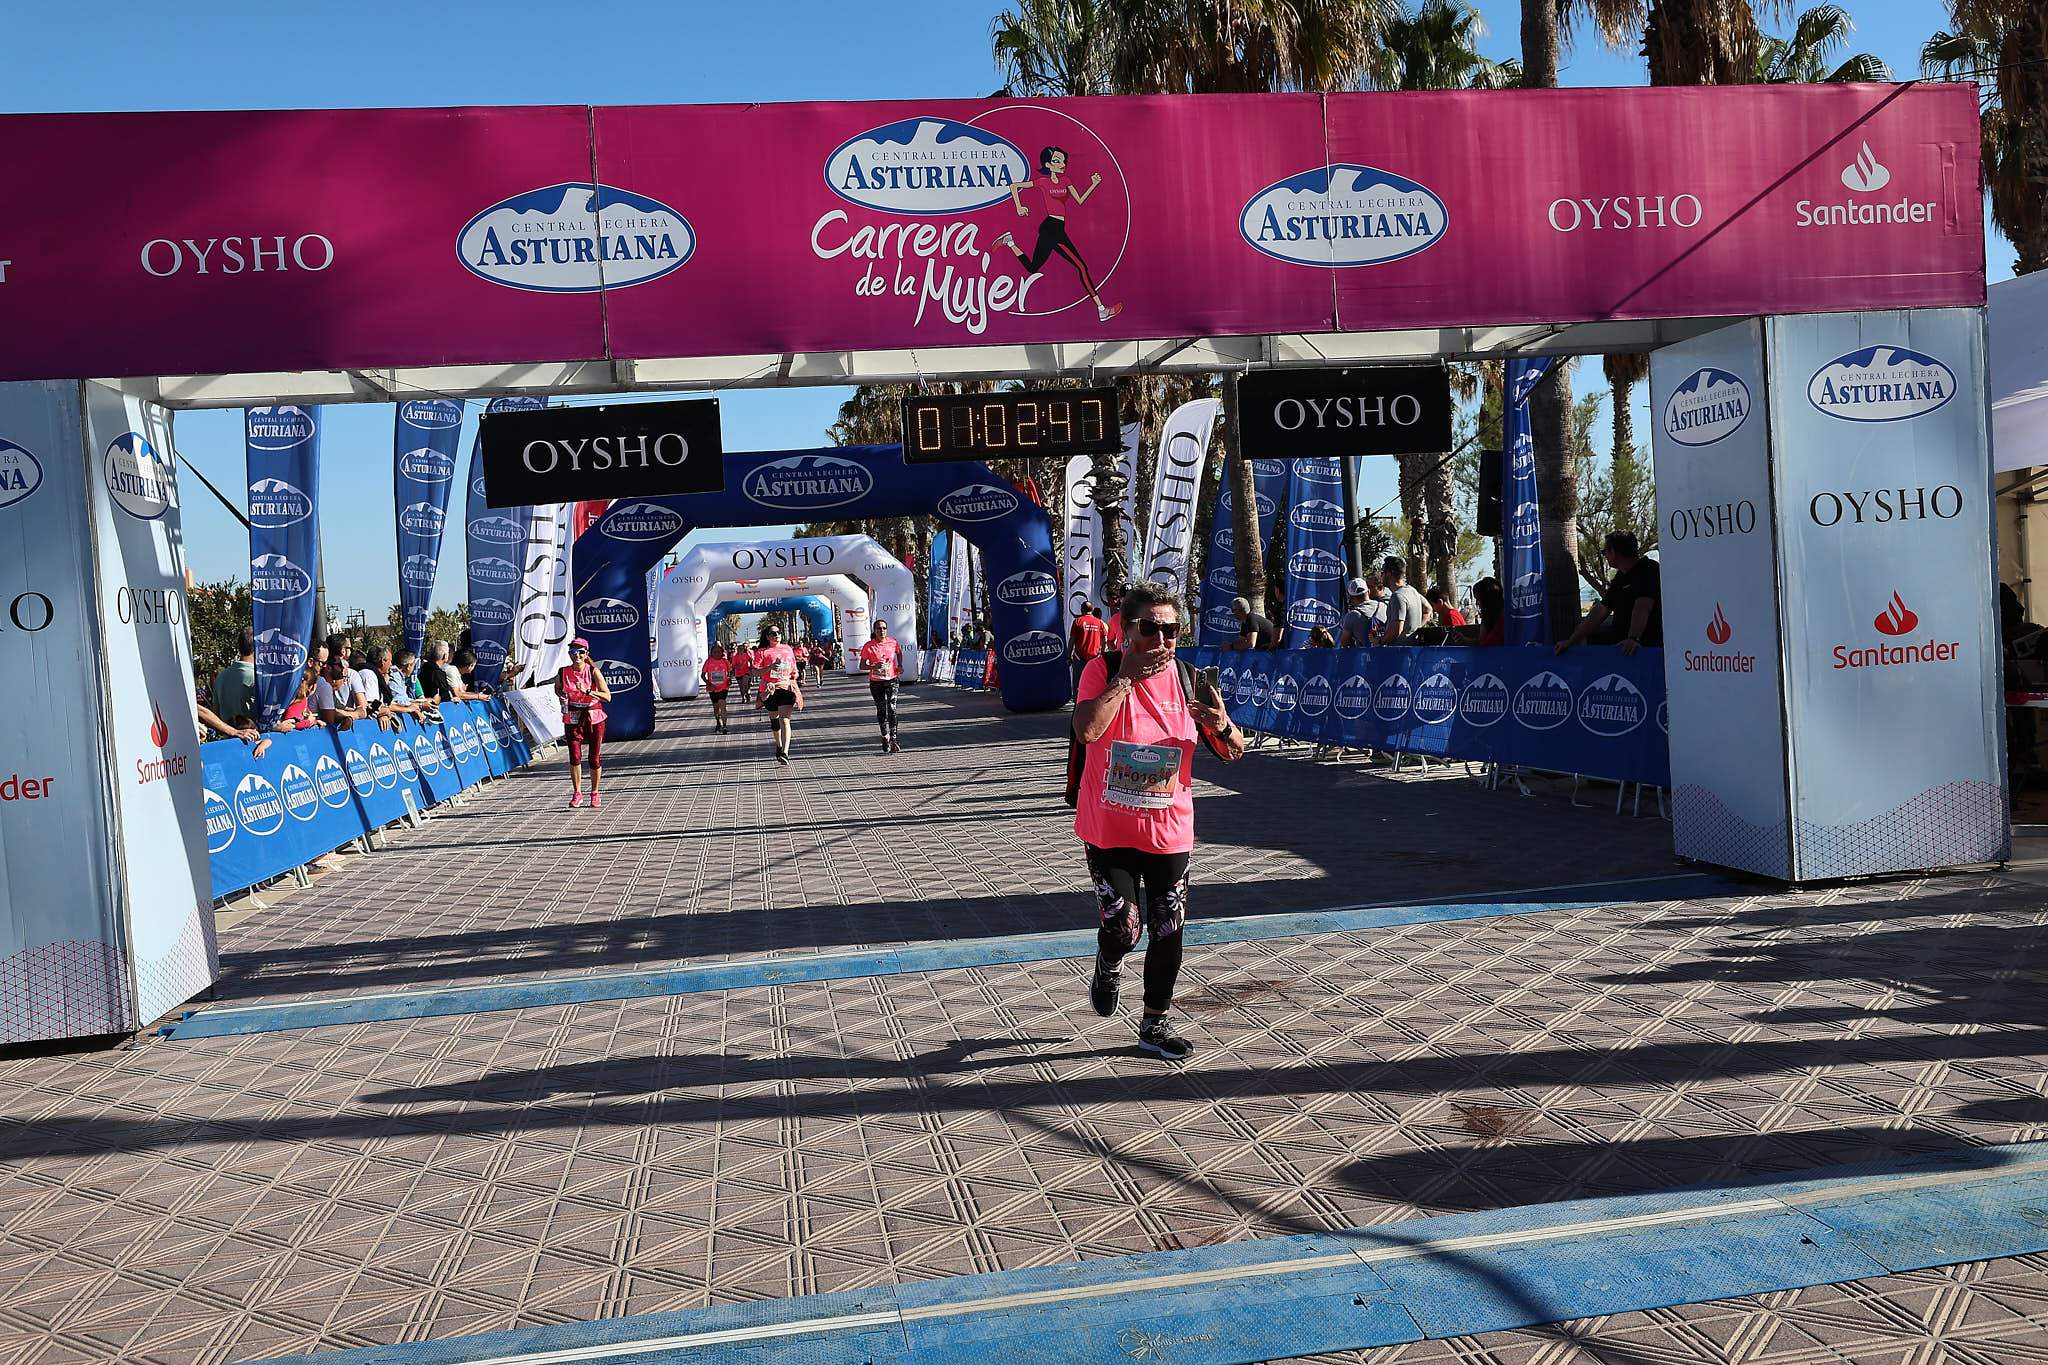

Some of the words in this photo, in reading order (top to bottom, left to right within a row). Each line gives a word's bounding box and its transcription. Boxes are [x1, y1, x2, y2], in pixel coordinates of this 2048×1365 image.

[871, 147, 936, 162] CENTRAL
[941, 146, 1008, 160] LECHERA
[841, 153, 1014, 191] ASTURIANA
[1287, 198, 1353, 211] CENTRAL
[1358, 196, 1426, 209] LECHERA
[1547, 193, 1703, 233] OYSHO
[1796, 197, 1937, 228] Santander
[511, 219, 587, 235] CENTRAL
[595, 216, 670, 231] ECHERA
[1257, 200, 1430, 243] ASTURIANA
[810, 208, 980, 261] Carrera
[140, 233, 335, 277] OYSHO
[477, 225, 679, 268] ASTURIANA
[855, 262, 887, 297] de
[893, 259, 916, 296] la
[911, 250, 1043, 334] Mujer
[1840, 372, 1888, 382] CENTRAL
[1891, 369, 1940, 380] LECHERA
[1680, 394, 1708, 408] CENTRAL
[1708, 386, 1740, 401] LECHERA
[1818, 376, 1947, 405] ASTURIANA
[406, 405, 457, 423] ASTURIANA
[1273, 394, 1422, 430] OYSHO
[1670, 396, 1745, 433] ASTURIANA
[917, 399, 1104, 451] 01:02:47
[522, 433, 690, 474] OYSHO
[110, 457, 169, 502] ASTURIANA
[771, 471, 814, 479] CENTRAL
[816, 468, 858, 477] LECHERA
[753, 474, 865, 497] ASTURIANA
[250, 503, 304, 516] STURIANA
[944, 499, 1014, 515] ASTURIANA
[1809, 485, 1964, 528] OYSHO
[471, 523, 523, 540] ASTURIANA
[605, 518, 677, 533] ASTURIANA
[1670, 500, 1756, 541] OYSHO
[732, 544, 835, 570] OYSHO
[864, 563, 895, 572] OYSHO
[671, 575, 704, 584] OYSHO
[1001, 584, 1055, 599] ASTURIANA
[117, 586, 181, 625] OYSHO
[882, 602, 911, 612] OYSHO
[579, 611, 635, 625] ASTURIANA
[660, 616, 690, 627] OYSHO
[662, 657, 692, 668] OYSHO
[1008, 644, 1062, 659] ASTURIANA
[1684, 649, 1756, 673] Santander
[1832, 638, 1960, 671] Santander
[1335, 691, 1368, 708] ASTURIANA
[1375, 691, 1408, 709] ASTURIANA
[1416, 691, 1453, 711] ASTURIANA
[1462, 691, 1504, 713] ASTURIANA
[1515, 692, 1568, 716] ASTURIANA
[1581, 695, 1638, 722] ASTURIANA
[137, 751, 188, 785] Santander
[284, 787, 316, 810] ASTURIANA
[239, 798, 282, 825] ASTURIANA
